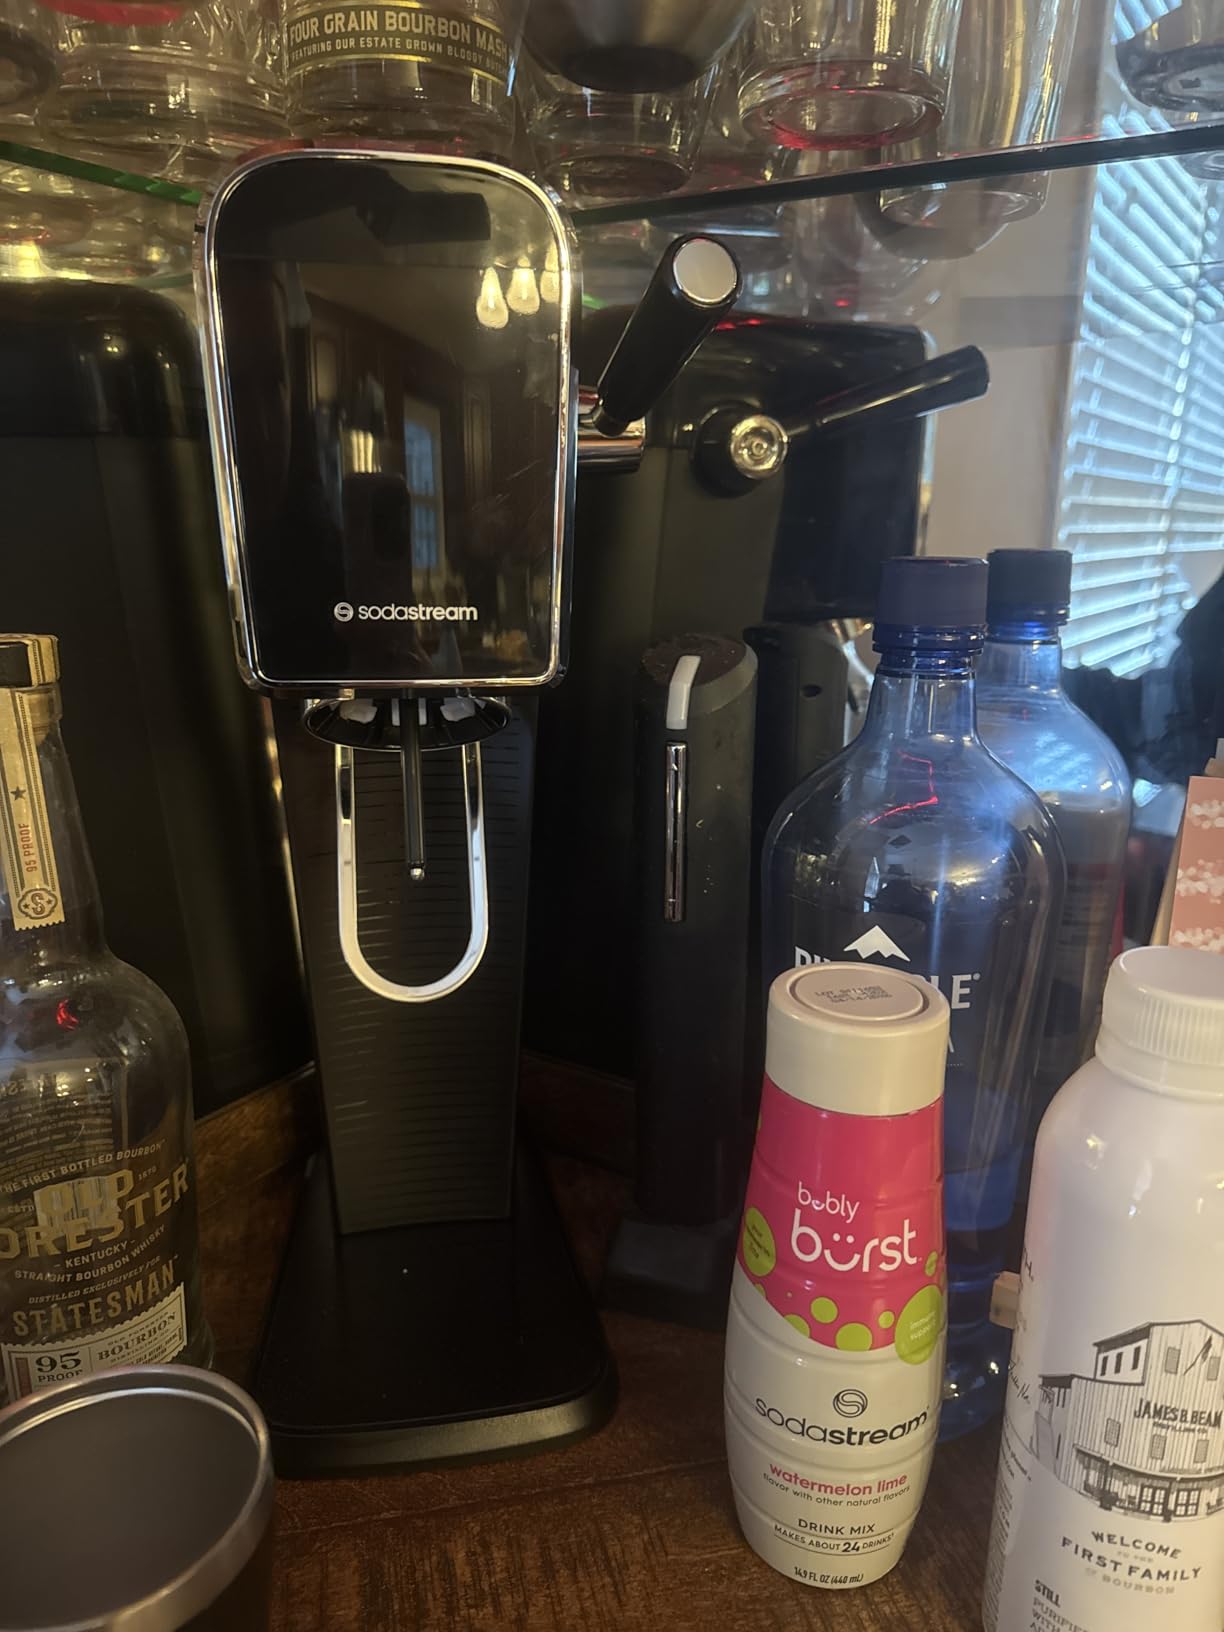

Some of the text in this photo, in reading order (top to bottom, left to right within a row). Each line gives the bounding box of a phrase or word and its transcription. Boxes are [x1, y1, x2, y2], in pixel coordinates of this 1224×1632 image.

[289, 10, 508, 60] FOUR GRAIN BOURBON MASH
[291, 40, 332, 62] FEATURING
[335, 38, 356, 50] OUR
[360, 37, 401, 49] ESTATE
[406, 39, 442, 53] GROWN
[358, 603, 479, 621] sodastream
[18, 822, 38, 873] 95 PROOF
[23, 1169, 57, 1188] FIRST
[61, 1154, 113, 1176] BOTTLED
[117, 1140, 163, 1161] BOURBON
[0, 1161, 190, 1260] ORESTER
[36, 1169, 133, 1217] OLD
[14, 1223, 166, 1283] STRAIGHT BOURBON WHISKY
[65, 1240, 128, 1269] KENTUCKY
[12, 1259, 176, 1337] STATESMAN
[28, 1290, 81, 1304] DISTILLED
[82, 1265, 144, 1296] EXCLUSIVELY
[97, 1311, 177, 1361] BOURBON
[35, 1351, 82, 1374] 95
[37, 1370, 83, 1384] PROOF
[755, 1398, 928, 1446] sodastream
[1133, 1397, 1179, 1422] JAMES
[763, 1472, 911, 1508] flavor with other natural flavors
[769, 1463, 908, 1496] watermelon lime
[774, 1522, 807, 1545] MAKES
[808, 1539, 841, 1551] ABOUT
[841, 1540, 861, 1554] 24
[797, 1518, 877, 1536] DRINK MIX
[1091, 1530, 1183, 1560] WELCOME
[808, 1570, 819, 1583] FL
[818, 1573, 831, 1584] OZ
[1061, 1536, 1203, 1583] FIRST FAMILY
[1101, 1573, 1177, 1596] BOURBON
[1032, 1596, 1091, 1632] PURIFIE
